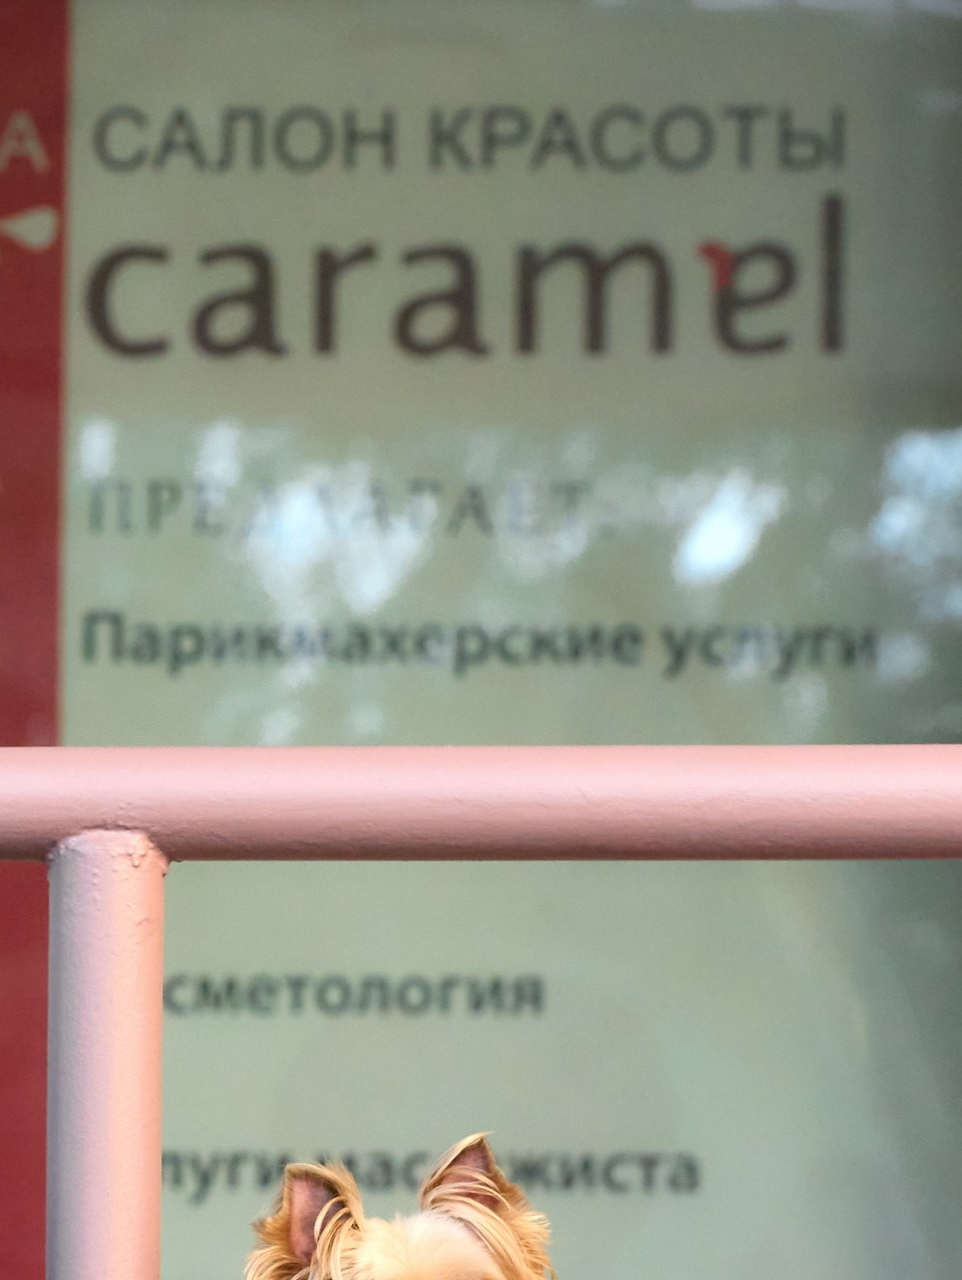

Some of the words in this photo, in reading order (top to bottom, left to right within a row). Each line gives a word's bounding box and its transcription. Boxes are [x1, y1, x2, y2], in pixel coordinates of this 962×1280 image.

[93, 106, 396, 172] САЛОН
[429, 106, 846, 172] КРАСОТЫ
[84, 192, 844, 358] caramel
[81, 612, 643, 677] Парикмахерские
[162, 974, 546, 1017] сметология
